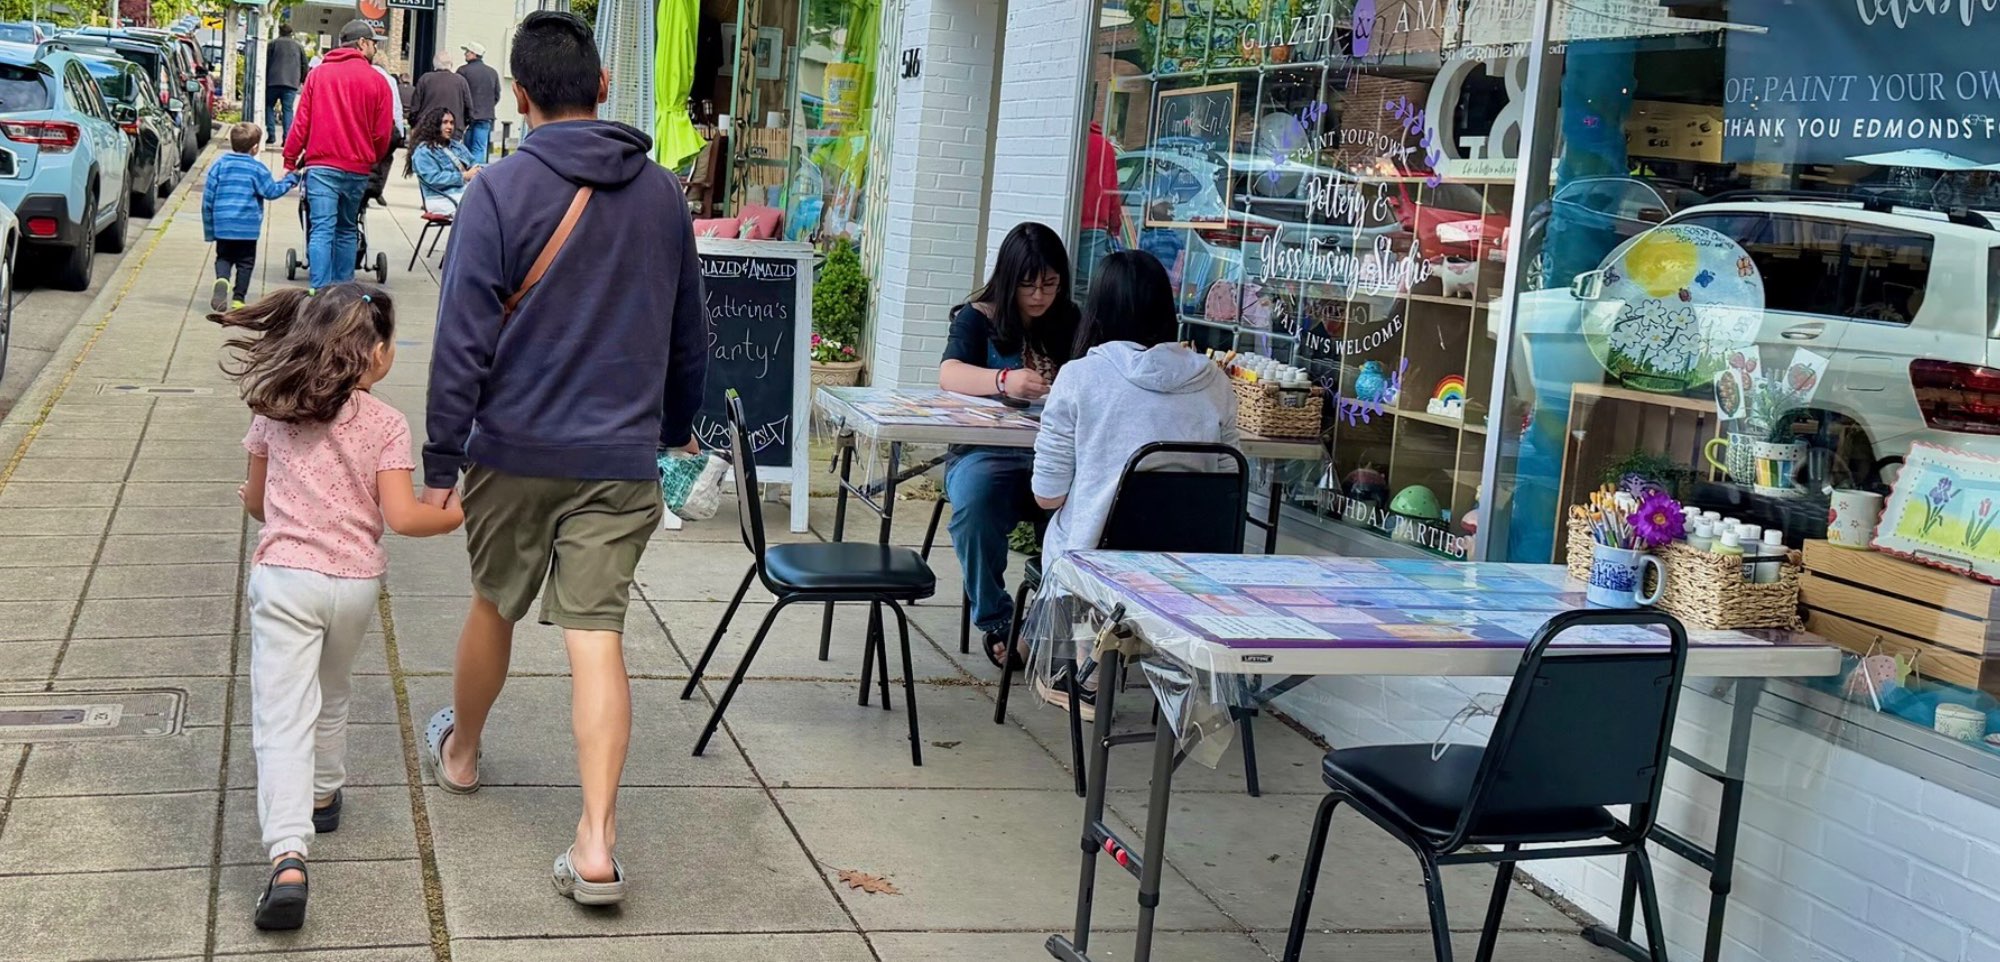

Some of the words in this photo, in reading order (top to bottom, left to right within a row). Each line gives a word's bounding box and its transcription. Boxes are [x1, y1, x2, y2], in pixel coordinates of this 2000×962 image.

[1242, 13, 1334, 50] GLAZED
[901, 47, 921, 79] 516
[1725, 77, 1755, 103] OF
[1763, 75, 1857, 103] PAINT
[1867, 72, 1947, 101] YOUR
[1340, 129, 1375, 148] YOUR
[1724, 118, 1785, 138] THANK
[1797, 118, 1841, 138] YOU
[1853, 118, 1973, 139] EDMONDS
[1305, 172, 1369, 240] Pottery
[1372, 182, 1391, 222] &
[1259, 223, 1305, 284] Glass
[1306, 236, 1361, 300] Fusing
[1365, 234, 1433, 296] Studio
[1335, 314, 1403, 356] WELCOME
[1394, 514, 1465, 559] PARTIES
